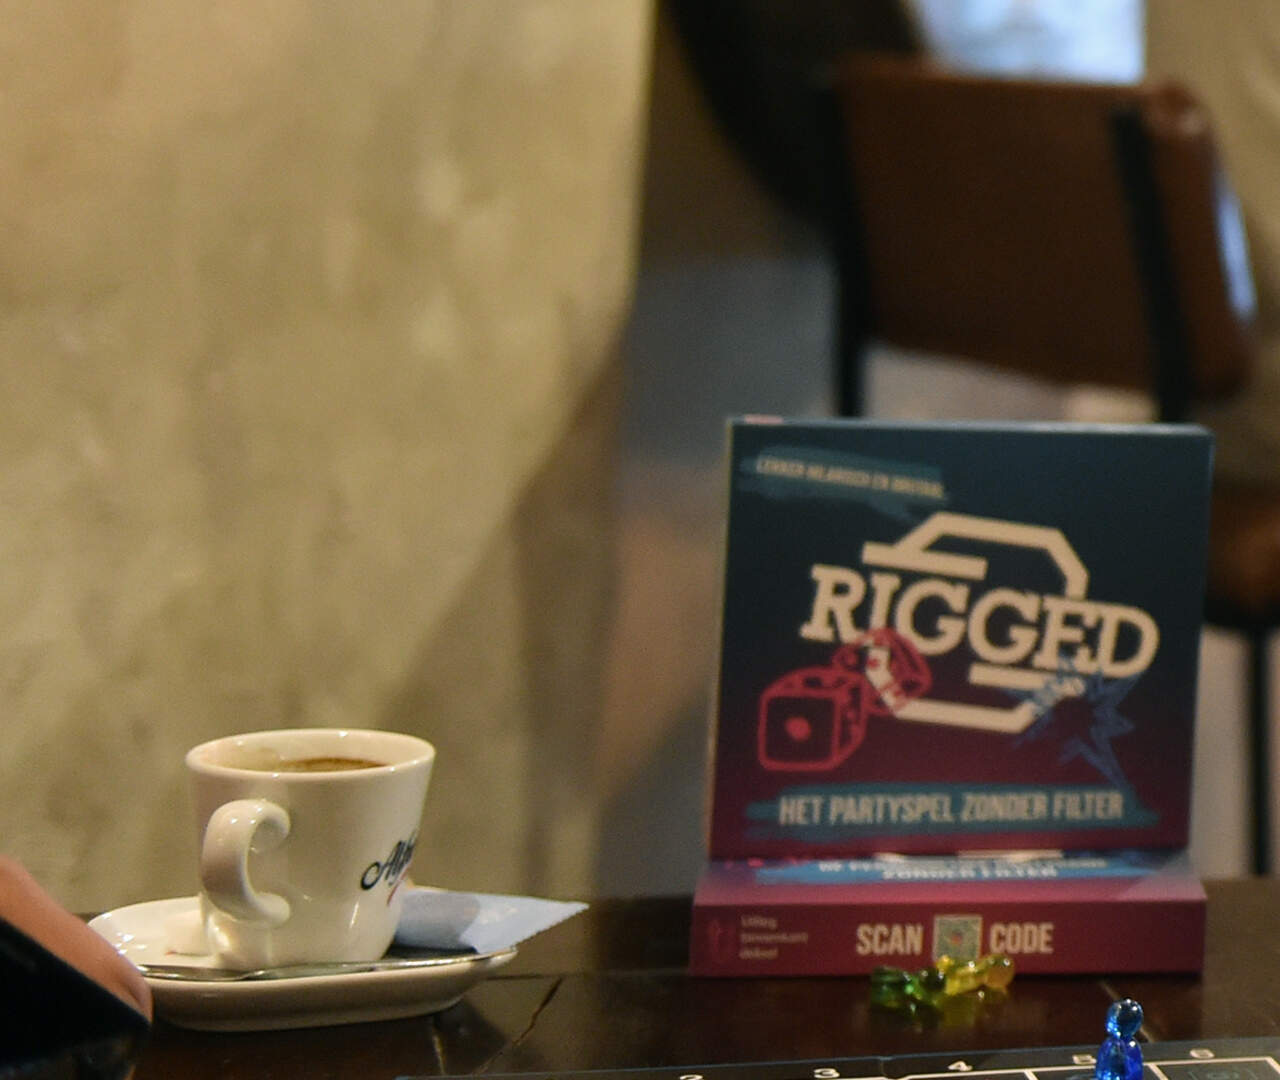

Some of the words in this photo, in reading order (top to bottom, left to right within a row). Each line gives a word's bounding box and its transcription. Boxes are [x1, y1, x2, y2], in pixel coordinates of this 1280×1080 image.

[800, 563, 1159, 679] RIGGED
[778, 795, 822, 826] HET
[829, 793, 954, 825] PARTYSPEL
[960, 791, 1048, 822] ZONDER
[1053, 789, 1124, 820] FILTER
[856, 923, 924, 956] SCAN
[989, 922, 1055, 955] CODE
[813, 1068, 840, 1079] 3
[948, 1060, 973, 1072] 4
[1189, 1048, 1215, 1059] 6
